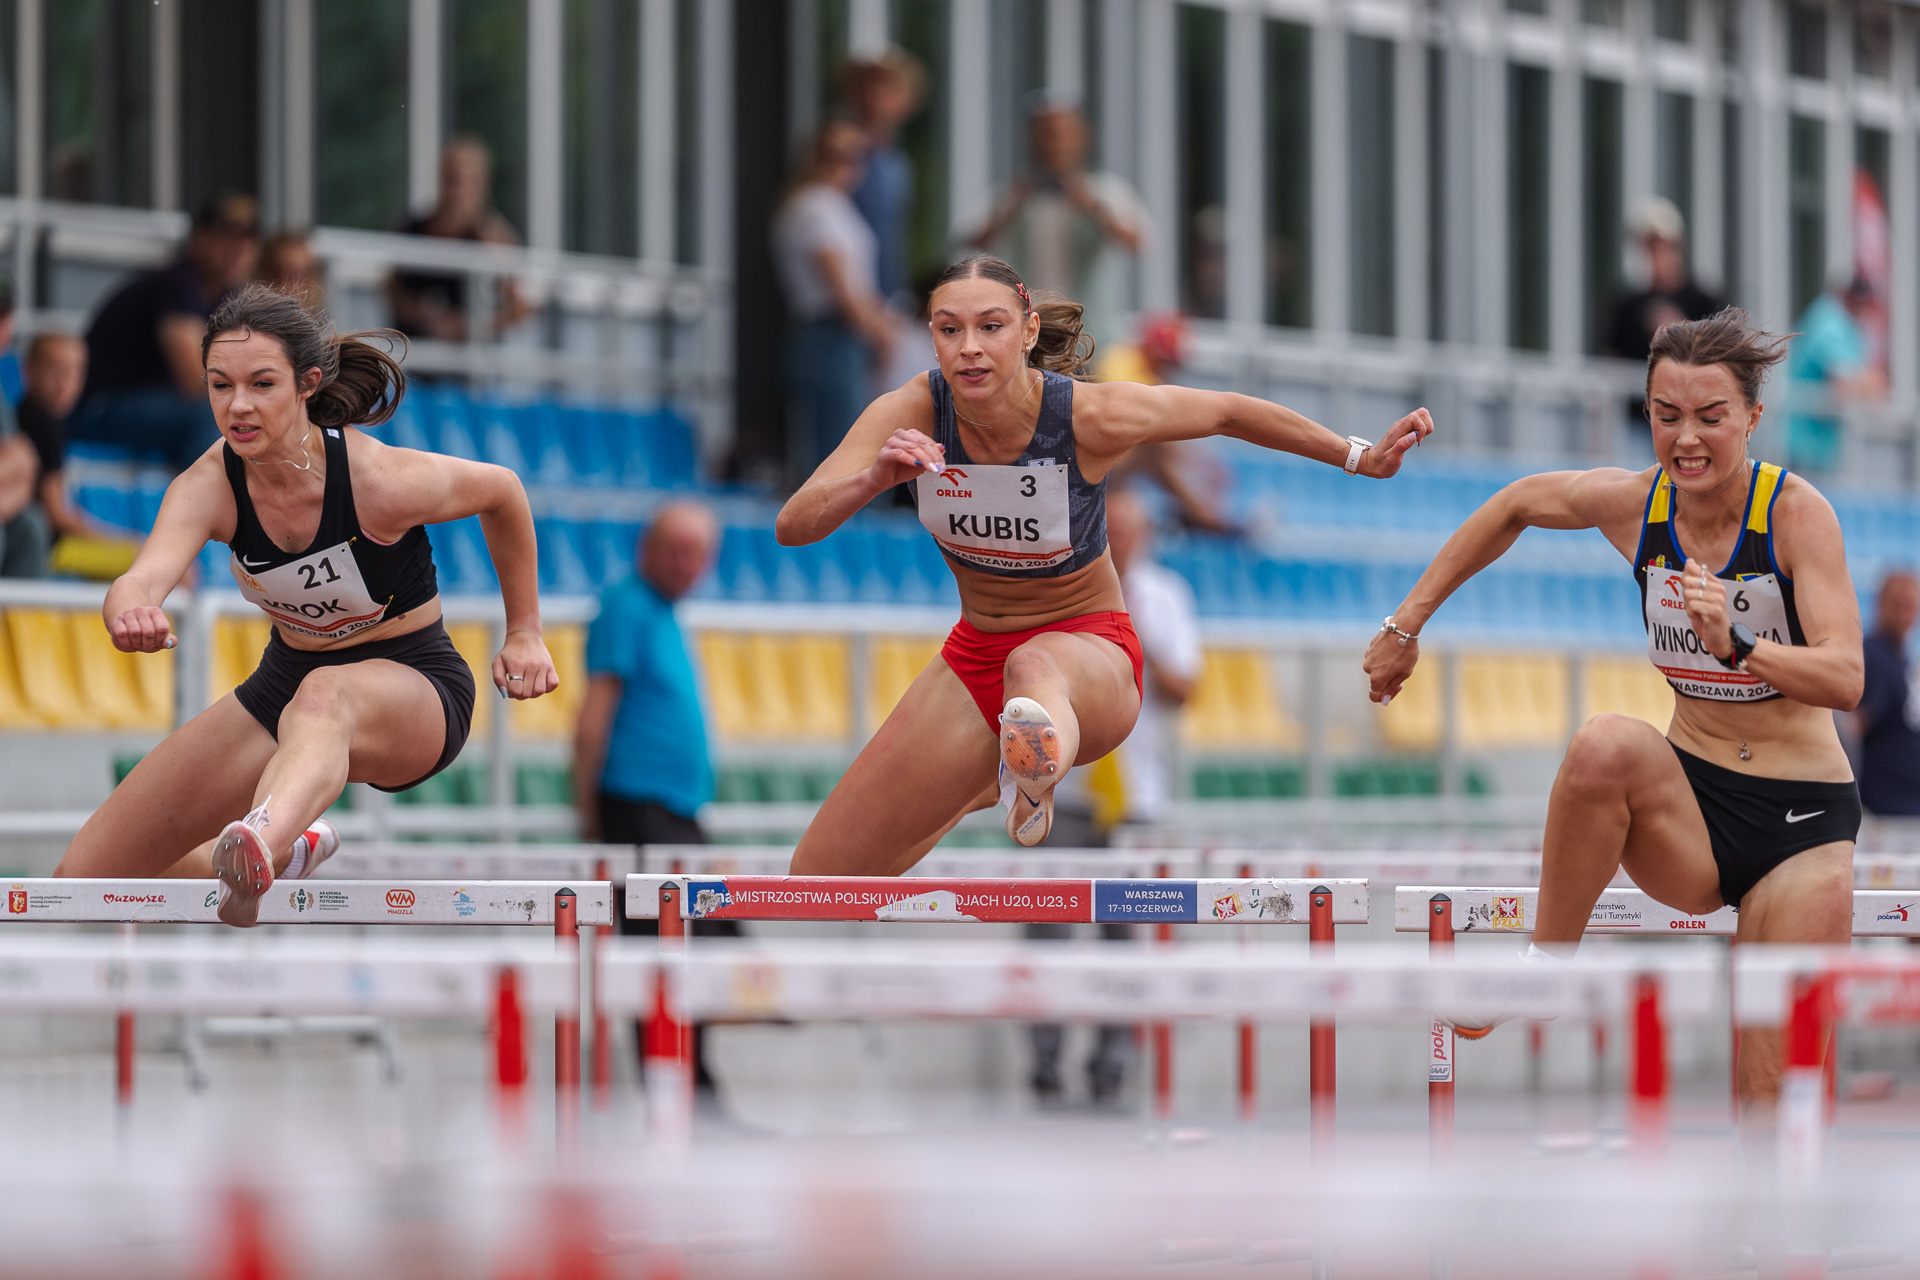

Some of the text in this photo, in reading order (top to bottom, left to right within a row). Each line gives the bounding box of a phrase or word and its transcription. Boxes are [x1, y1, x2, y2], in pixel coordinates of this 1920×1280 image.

[1020, 475, 1037, 497] 3
[936, 489, 972, 498] ORLEN
[949, 513, 1040, 542] KUBIS
[297, 557, 341, 590] 21
[1661, 598, 1686, 610] ORLE
[1733, 590, 1750, 612] 6
[1747, 684, 1777, 697] 202
[736, 890, 832, 903] MISTRZOSTWA
[835, 892, 881, 904] POLSKI
[885, 893, 898, 905] W
[1003, 895, 1034, 909] U20,
[1037, 896, 1067, 909] U23,
[1070, 896, 1078, 907] S
[1124, 891, 1184, 899] WARSZAWA
[913, 903, 927, 911] KIDS
[1108, 904, 1184, 913] 17-19 CZERWCA
[1608, 912, 1641, 920] Turystyki
[1494, 919, 1521, 927] PZLA
[1670, 921, 1705, 929] ORLEN
